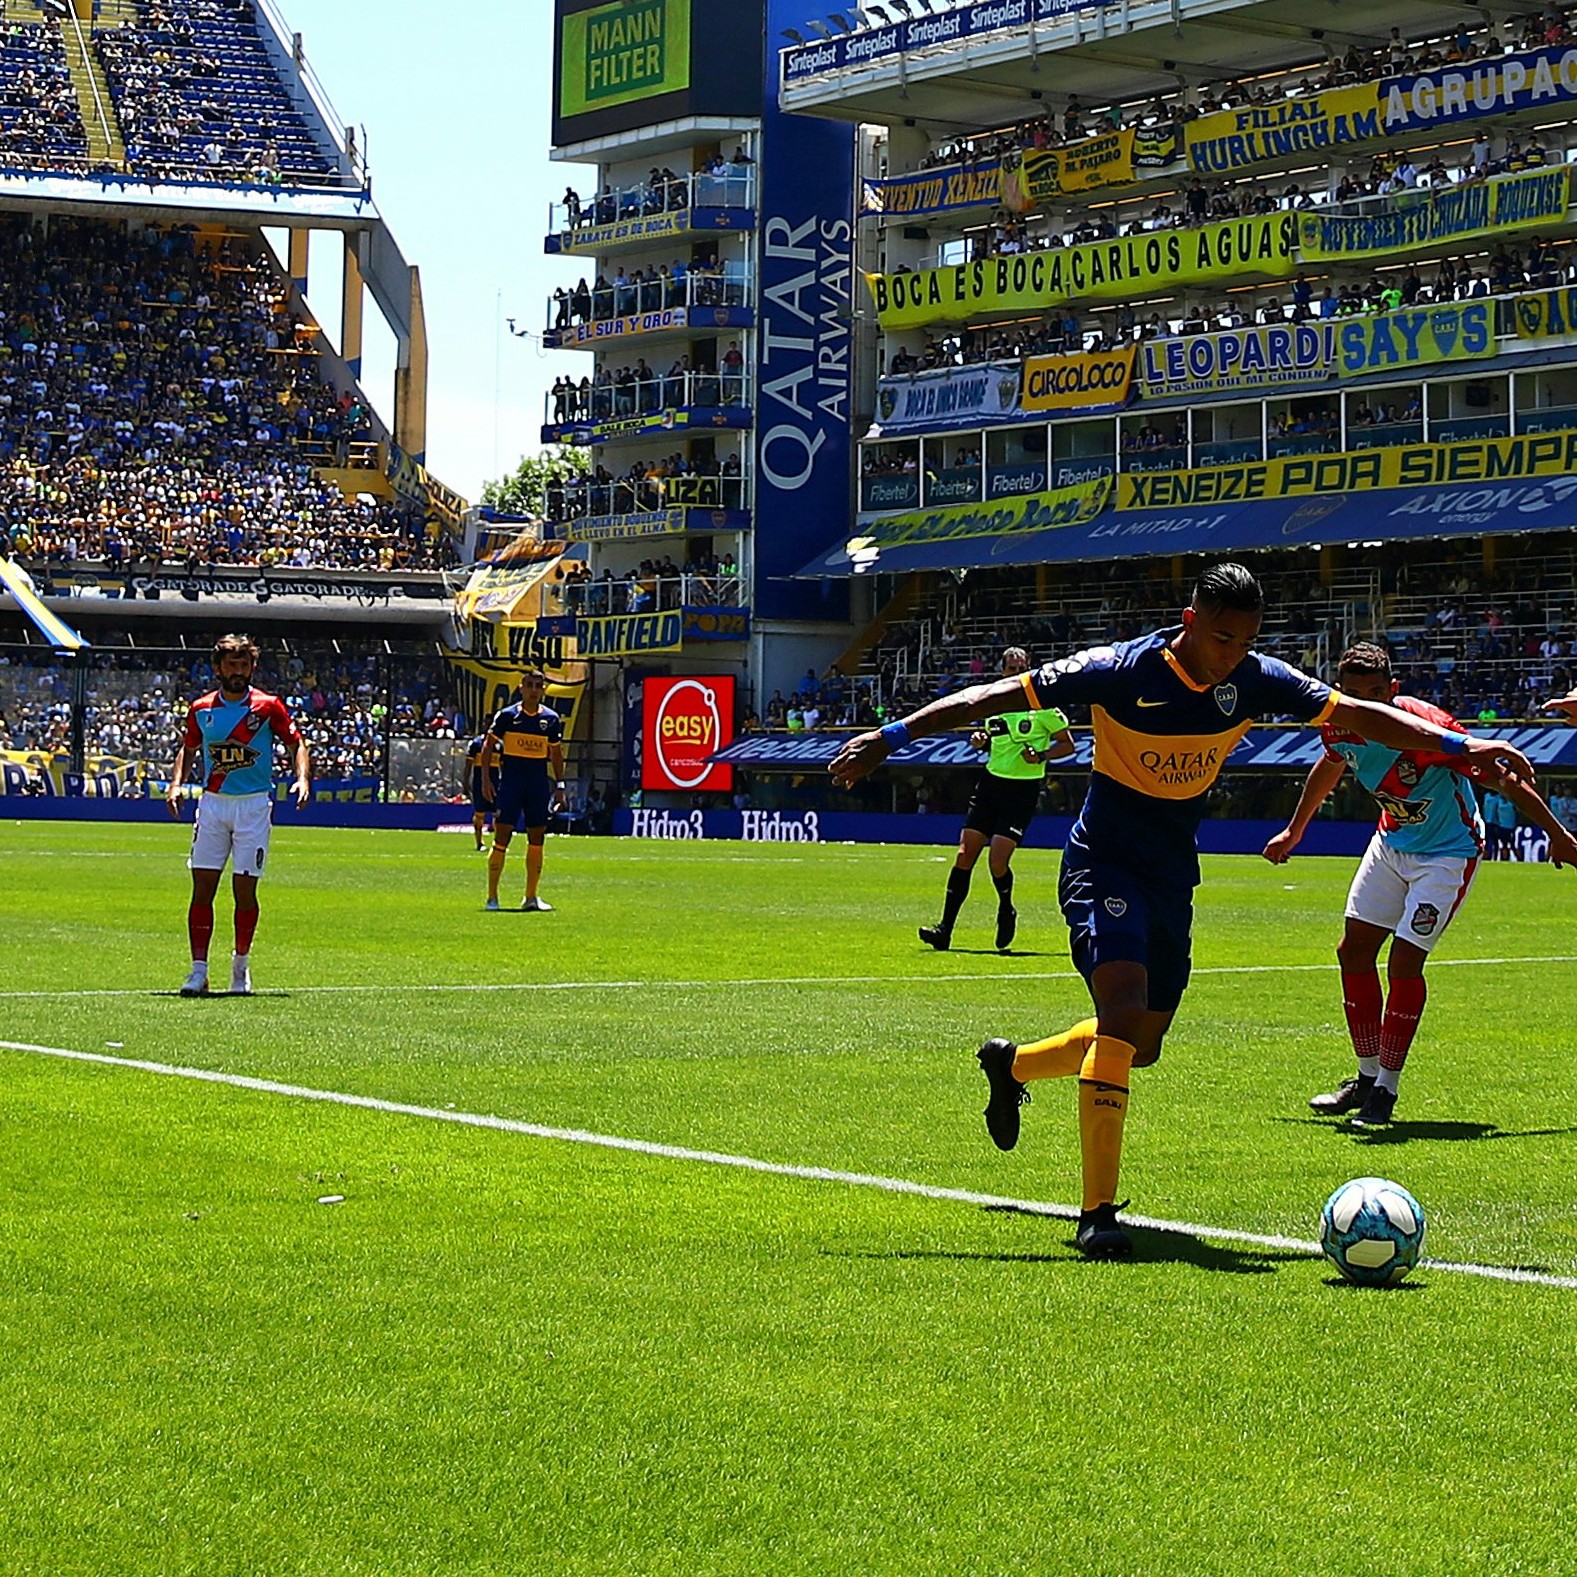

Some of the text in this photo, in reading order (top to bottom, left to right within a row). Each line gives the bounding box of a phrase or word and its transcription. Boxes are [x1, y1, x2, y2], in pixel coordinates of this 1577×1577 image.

[590, 7, 661, 54] MANN
[844, 30, 897, 61] Sinteplast
[906, 14, 960, 45] Sinteplast
[589, 44, 661, 90] FILTER
[1235, 93, 1326, 131] FILIAL
[1191, 110, 1384, 173] HURLINGHAM
[645, 218, 672, 233] BOCA
[1070, 215, 1291, 291] CARLOS AGUAS
[876, 256, 1064, 312] BOCA ES BOCA
[577, 312, 671, 341] EL SUR Y ORO
[819, 217, 853, 424] AIRWAYS
[760, 215, 826, 490] QATAR
[1144, 323, 1337, 384] LEOPARDI
[1028, 362, 1126, 399] CIRCOLOCO
[870, 484, 911, 503] Fibertel
[992, 472, 1035, 492] Fibertel
[1127, 466, 1268, 509] XENEIZE
[1387, 484, 1527, 517] AXION
[1087, 524, 1117, 539] LA
[155, 577, 248, 593] GATORADE
[270, 581, 364, 597] GATORADE
[577, 614, 682, 655] BANFIELD
[662, 713, 714, 745] easy
[221, 747, 245, 763] LN
[1139, 746, 1218, 771] QATAR
[1247, 729, 1324, 766] LA
[631, 809, 704, 840] Hidro3
[741, 810, 819, 842] Hidro3
